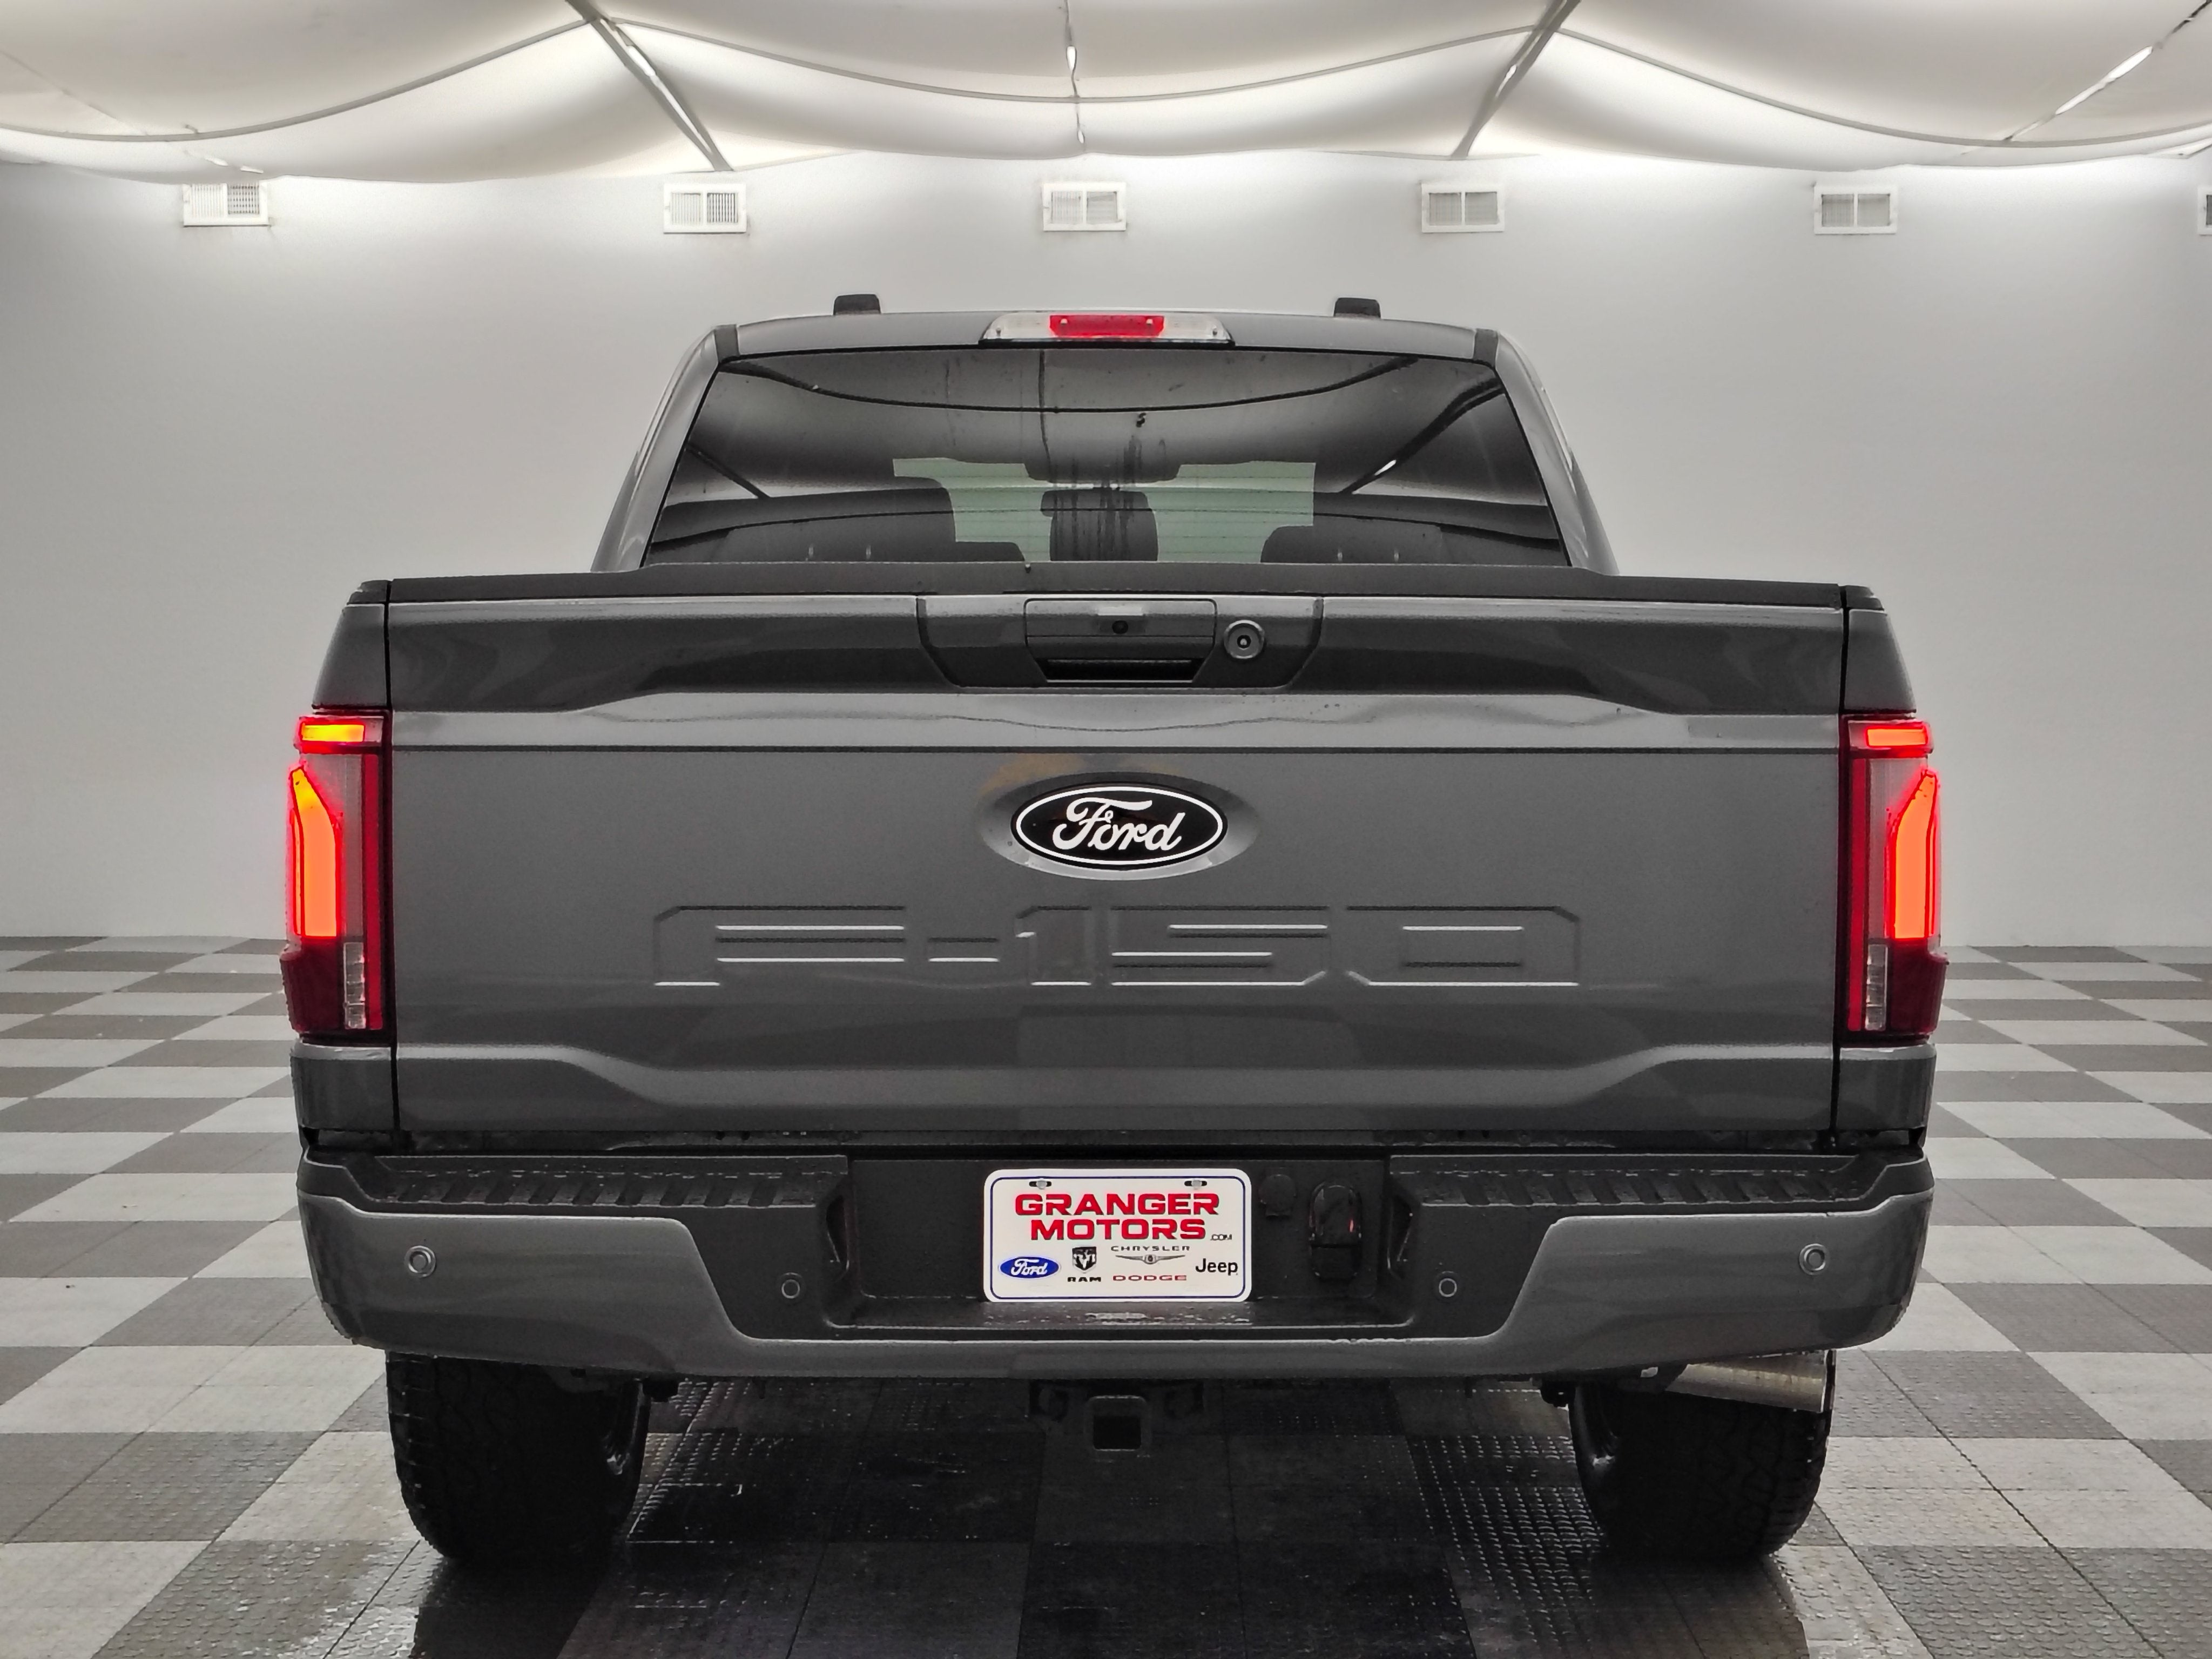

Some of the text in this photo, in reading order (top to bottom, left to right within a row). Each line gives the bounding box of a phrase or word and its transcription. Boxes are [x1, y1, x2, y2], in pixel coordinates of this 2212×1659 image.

[1053, 797, 1185, 850] Ford
[654, 905, 1580, 986] F-150
[1015, 1192, 1219, 1216] GRANGER
[1031, 1218, 1206, 1240] MOTORS
[1010, 1258, 1048, 1276] Ford
[1195, 1258, 1238, 1276] Jeep
